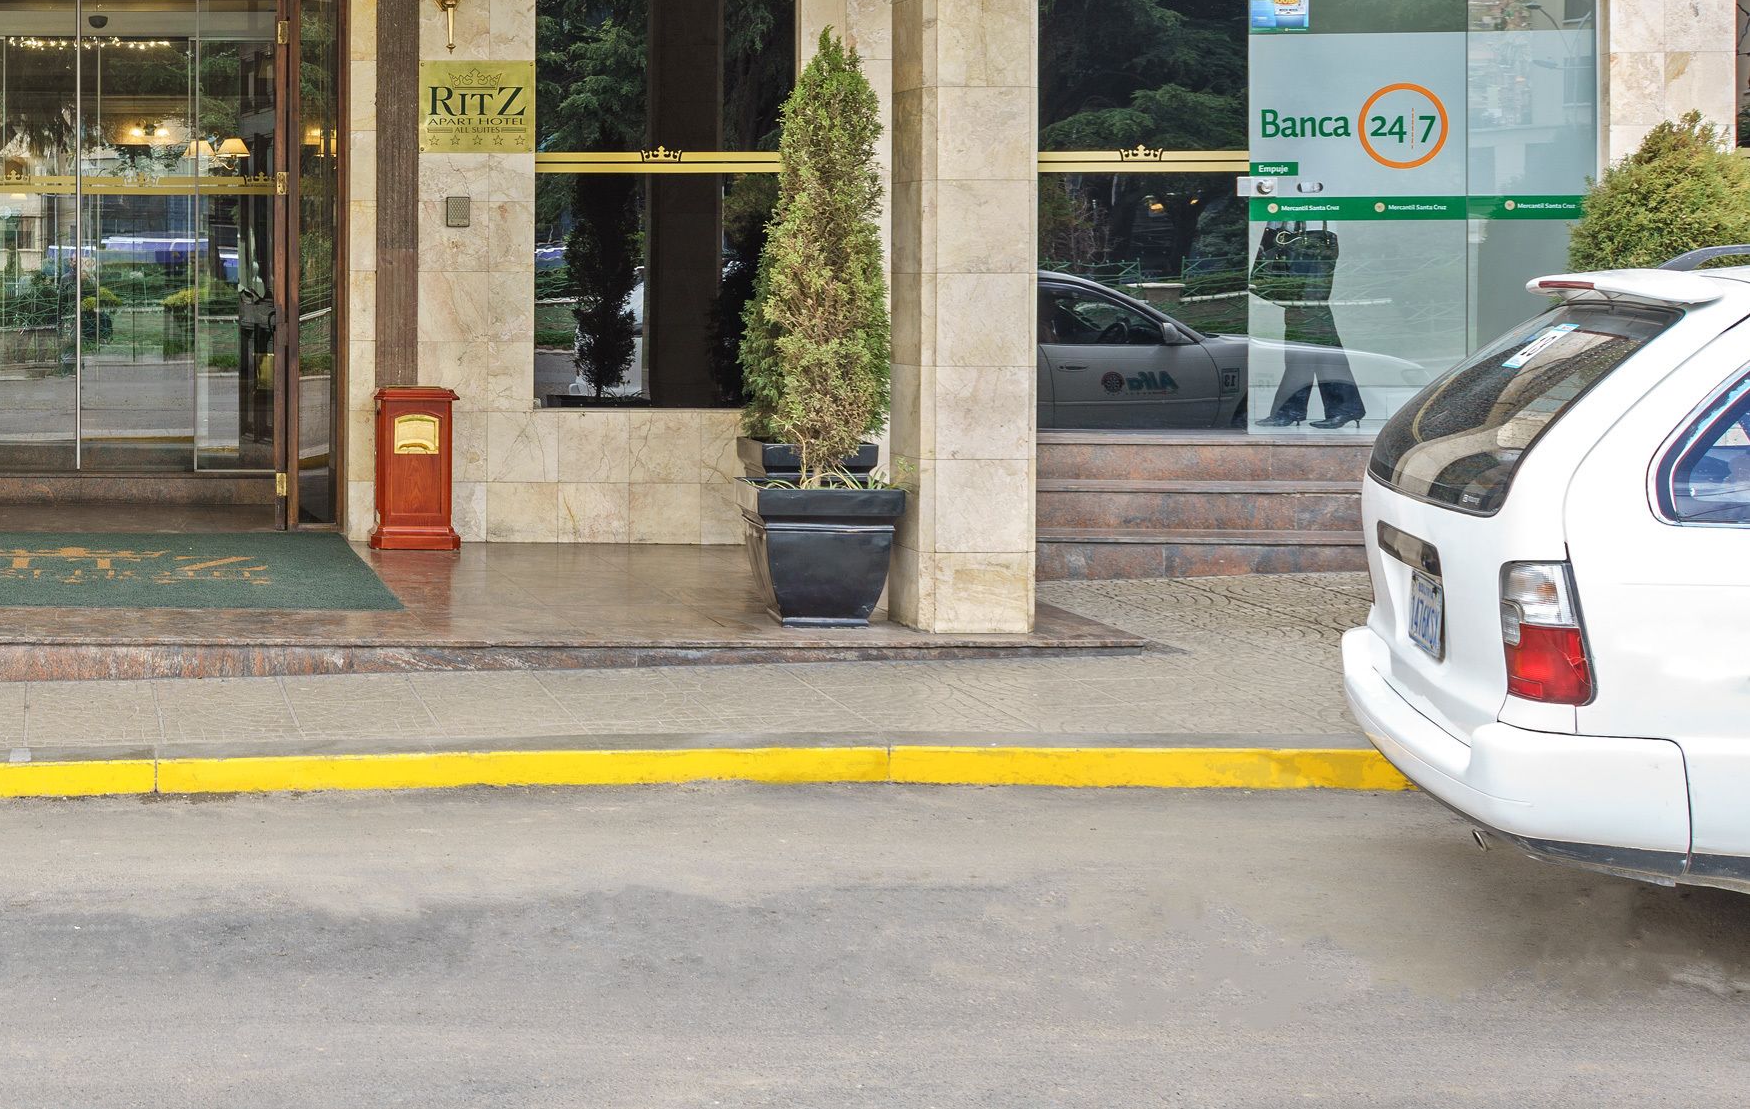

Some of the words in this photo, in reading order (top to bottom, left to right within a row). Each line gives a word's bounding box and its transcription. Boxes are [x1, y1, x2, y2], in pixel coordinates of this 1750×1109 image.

[427, 86, 527, 116] RITZ
[428, 117, 474, 126] APART
[479, 117, 527, 126] HOTEL
[1260, 108, 1352, 139] Banca
[454, 126, 469, 134] ALL
[471, 126, 501, 134] SUITES
[1257, 164, 1289, 175] Empuje
